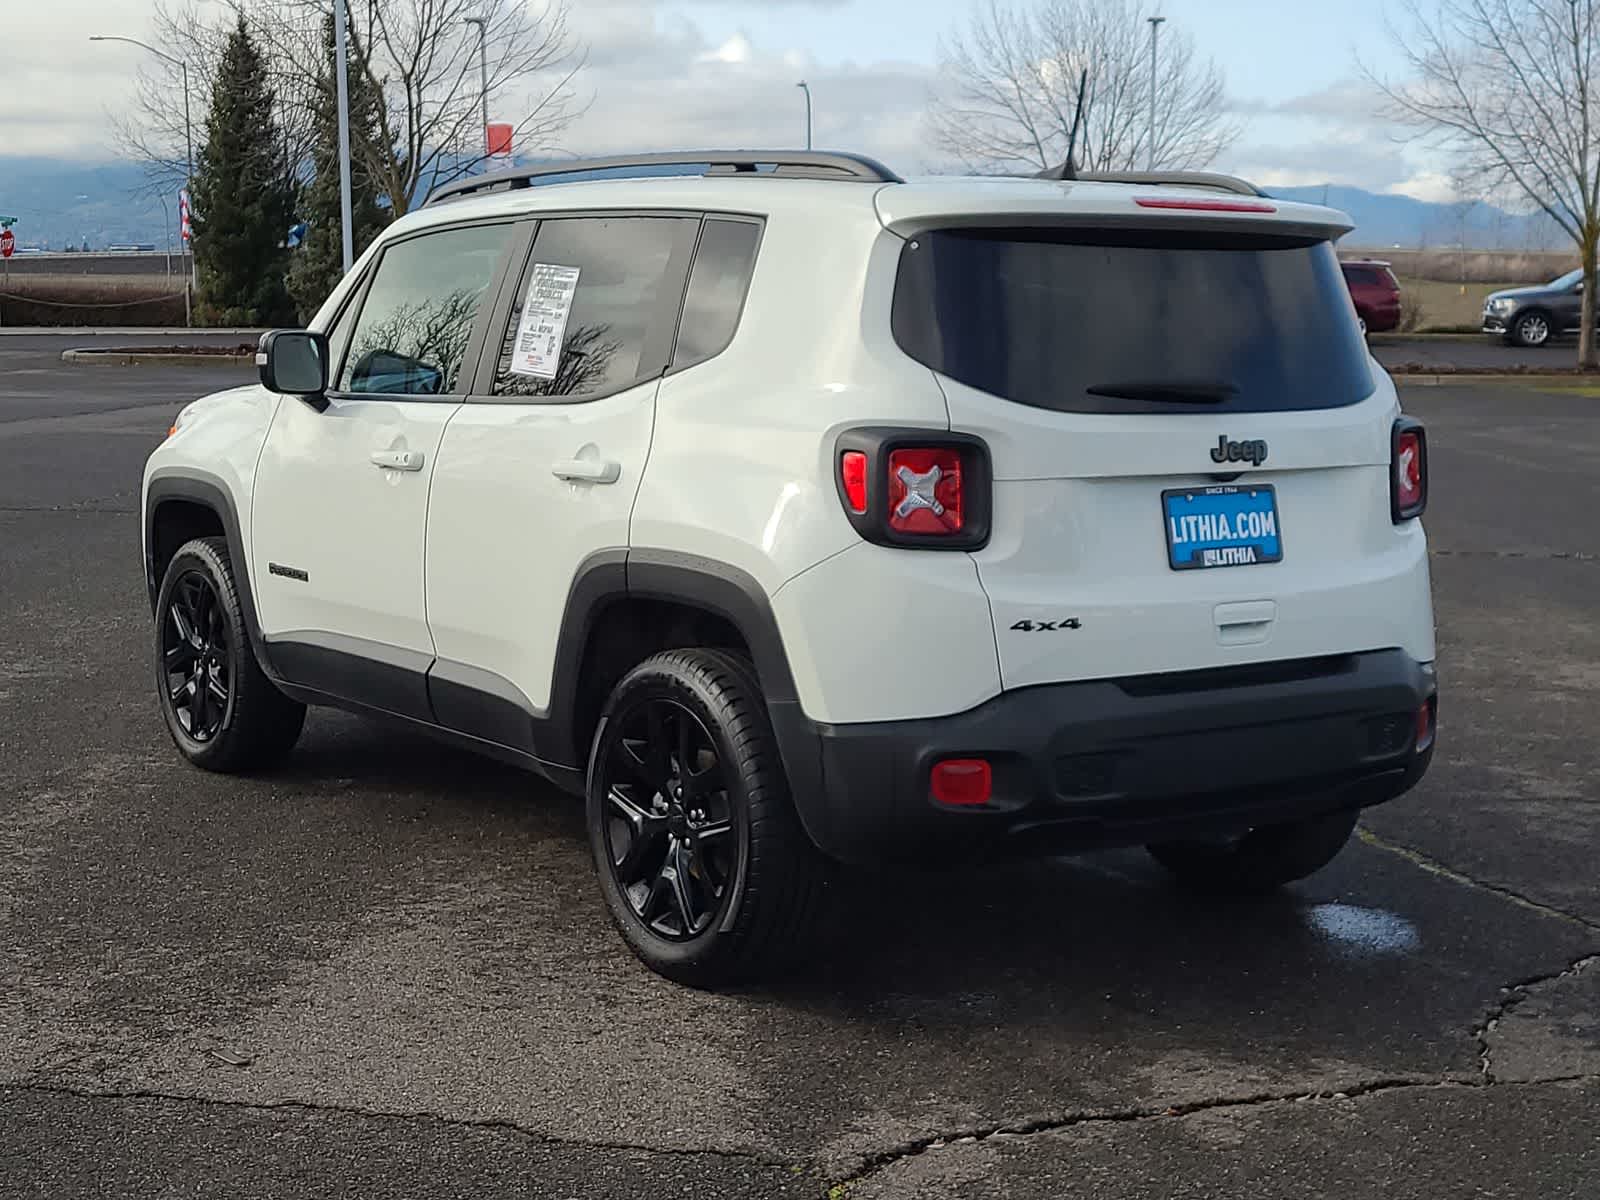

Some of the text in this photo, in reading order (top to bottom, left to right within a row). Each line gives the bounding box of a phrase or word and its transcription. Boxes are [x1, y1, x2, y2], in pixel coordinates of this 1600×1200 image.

[1210, 434, 1268, 467] Jeep
[1170, 511, 1276, 543] LITHIA.COM
[1215, 546, 1257, 565] LITHIA
[1009, 617, 1082, 632] 4x4
